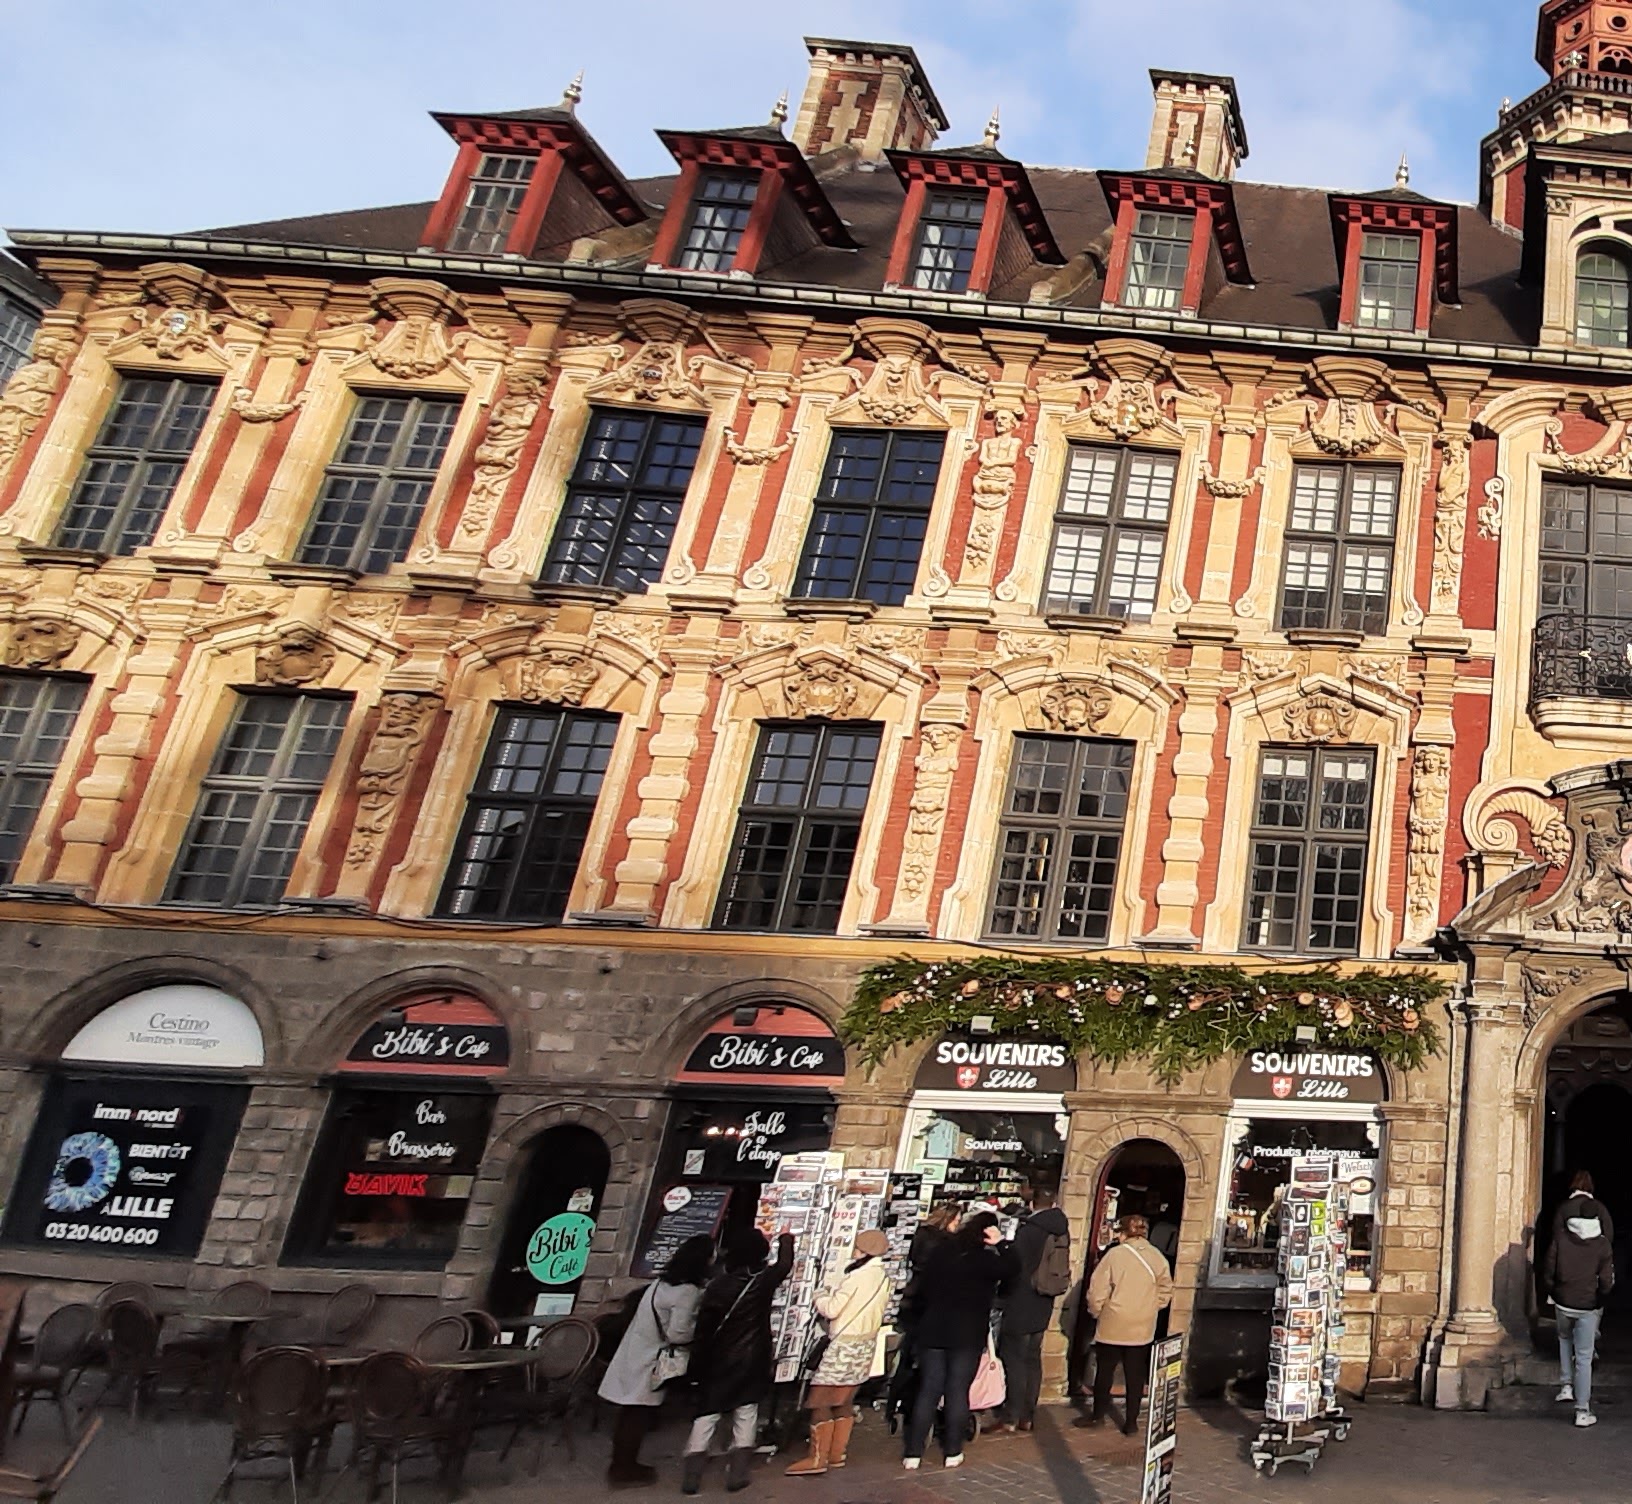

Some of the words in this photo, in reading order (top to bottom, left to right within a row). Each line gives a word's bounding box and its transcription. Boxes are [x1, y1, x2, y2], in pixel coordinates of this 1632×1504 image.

[149, 1012, 210, 1031] Cestino
[372, 1026, 452, 1058] Bibi's
[709, 1035, 788, 1069] Bibi's
[936, 1041, 1066, 1067] SOUVENIRS
[1250, 1051, 1374, 1077] SOUVENIRS
[982, 1068, 1038, 1089] Lille
[1297, 1079, 1349, 1099] Lille
[416, 1099, 447, 1125] Bar
[388, 1130, 456, 1159] Brasserie
[964, 1137, 1024, 1151] Souvenirs
[108, 1195, 174, 1219] LILLE
